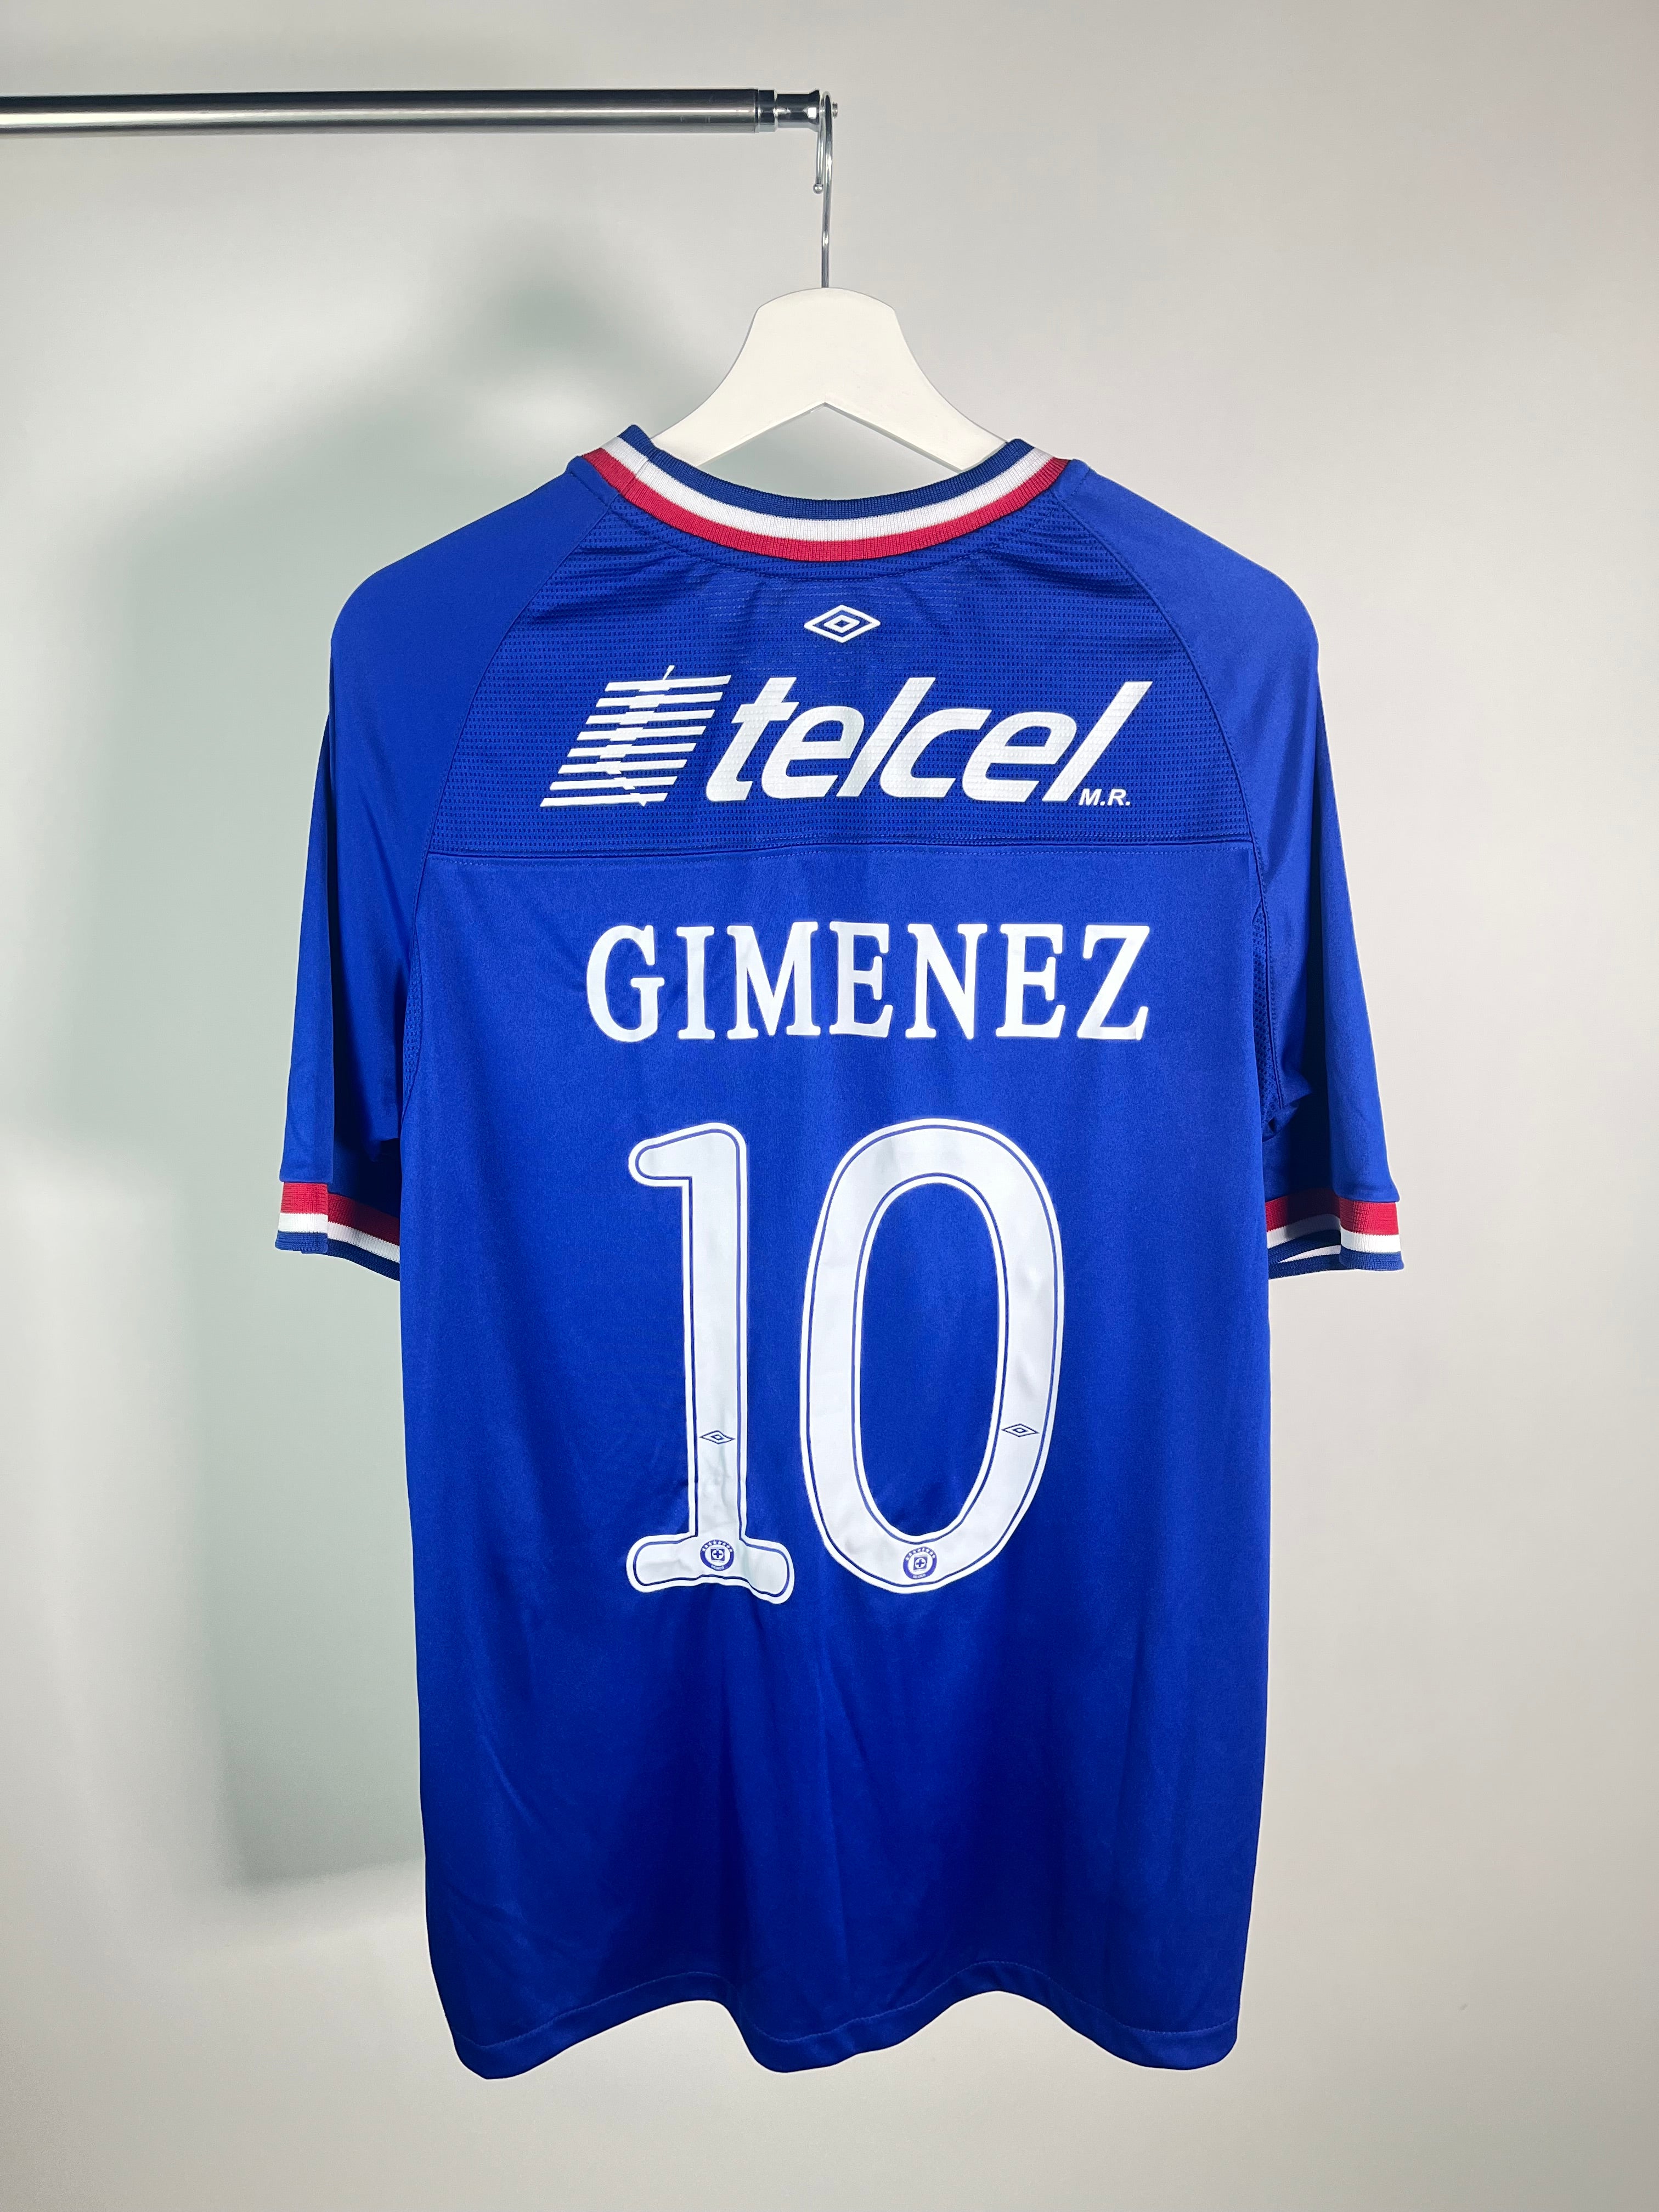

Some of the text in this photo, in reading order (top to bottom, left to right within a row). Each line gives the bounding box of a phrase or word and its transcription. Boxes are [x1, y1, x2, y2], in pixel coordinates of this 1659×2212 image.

[706, 677, 1153, 802] telcel
[1078, 788, 1131, 806] M.R.
[586, 921, 1150, 1043] GIMENEZ
[626, 1118, 1064, 1604] 10
